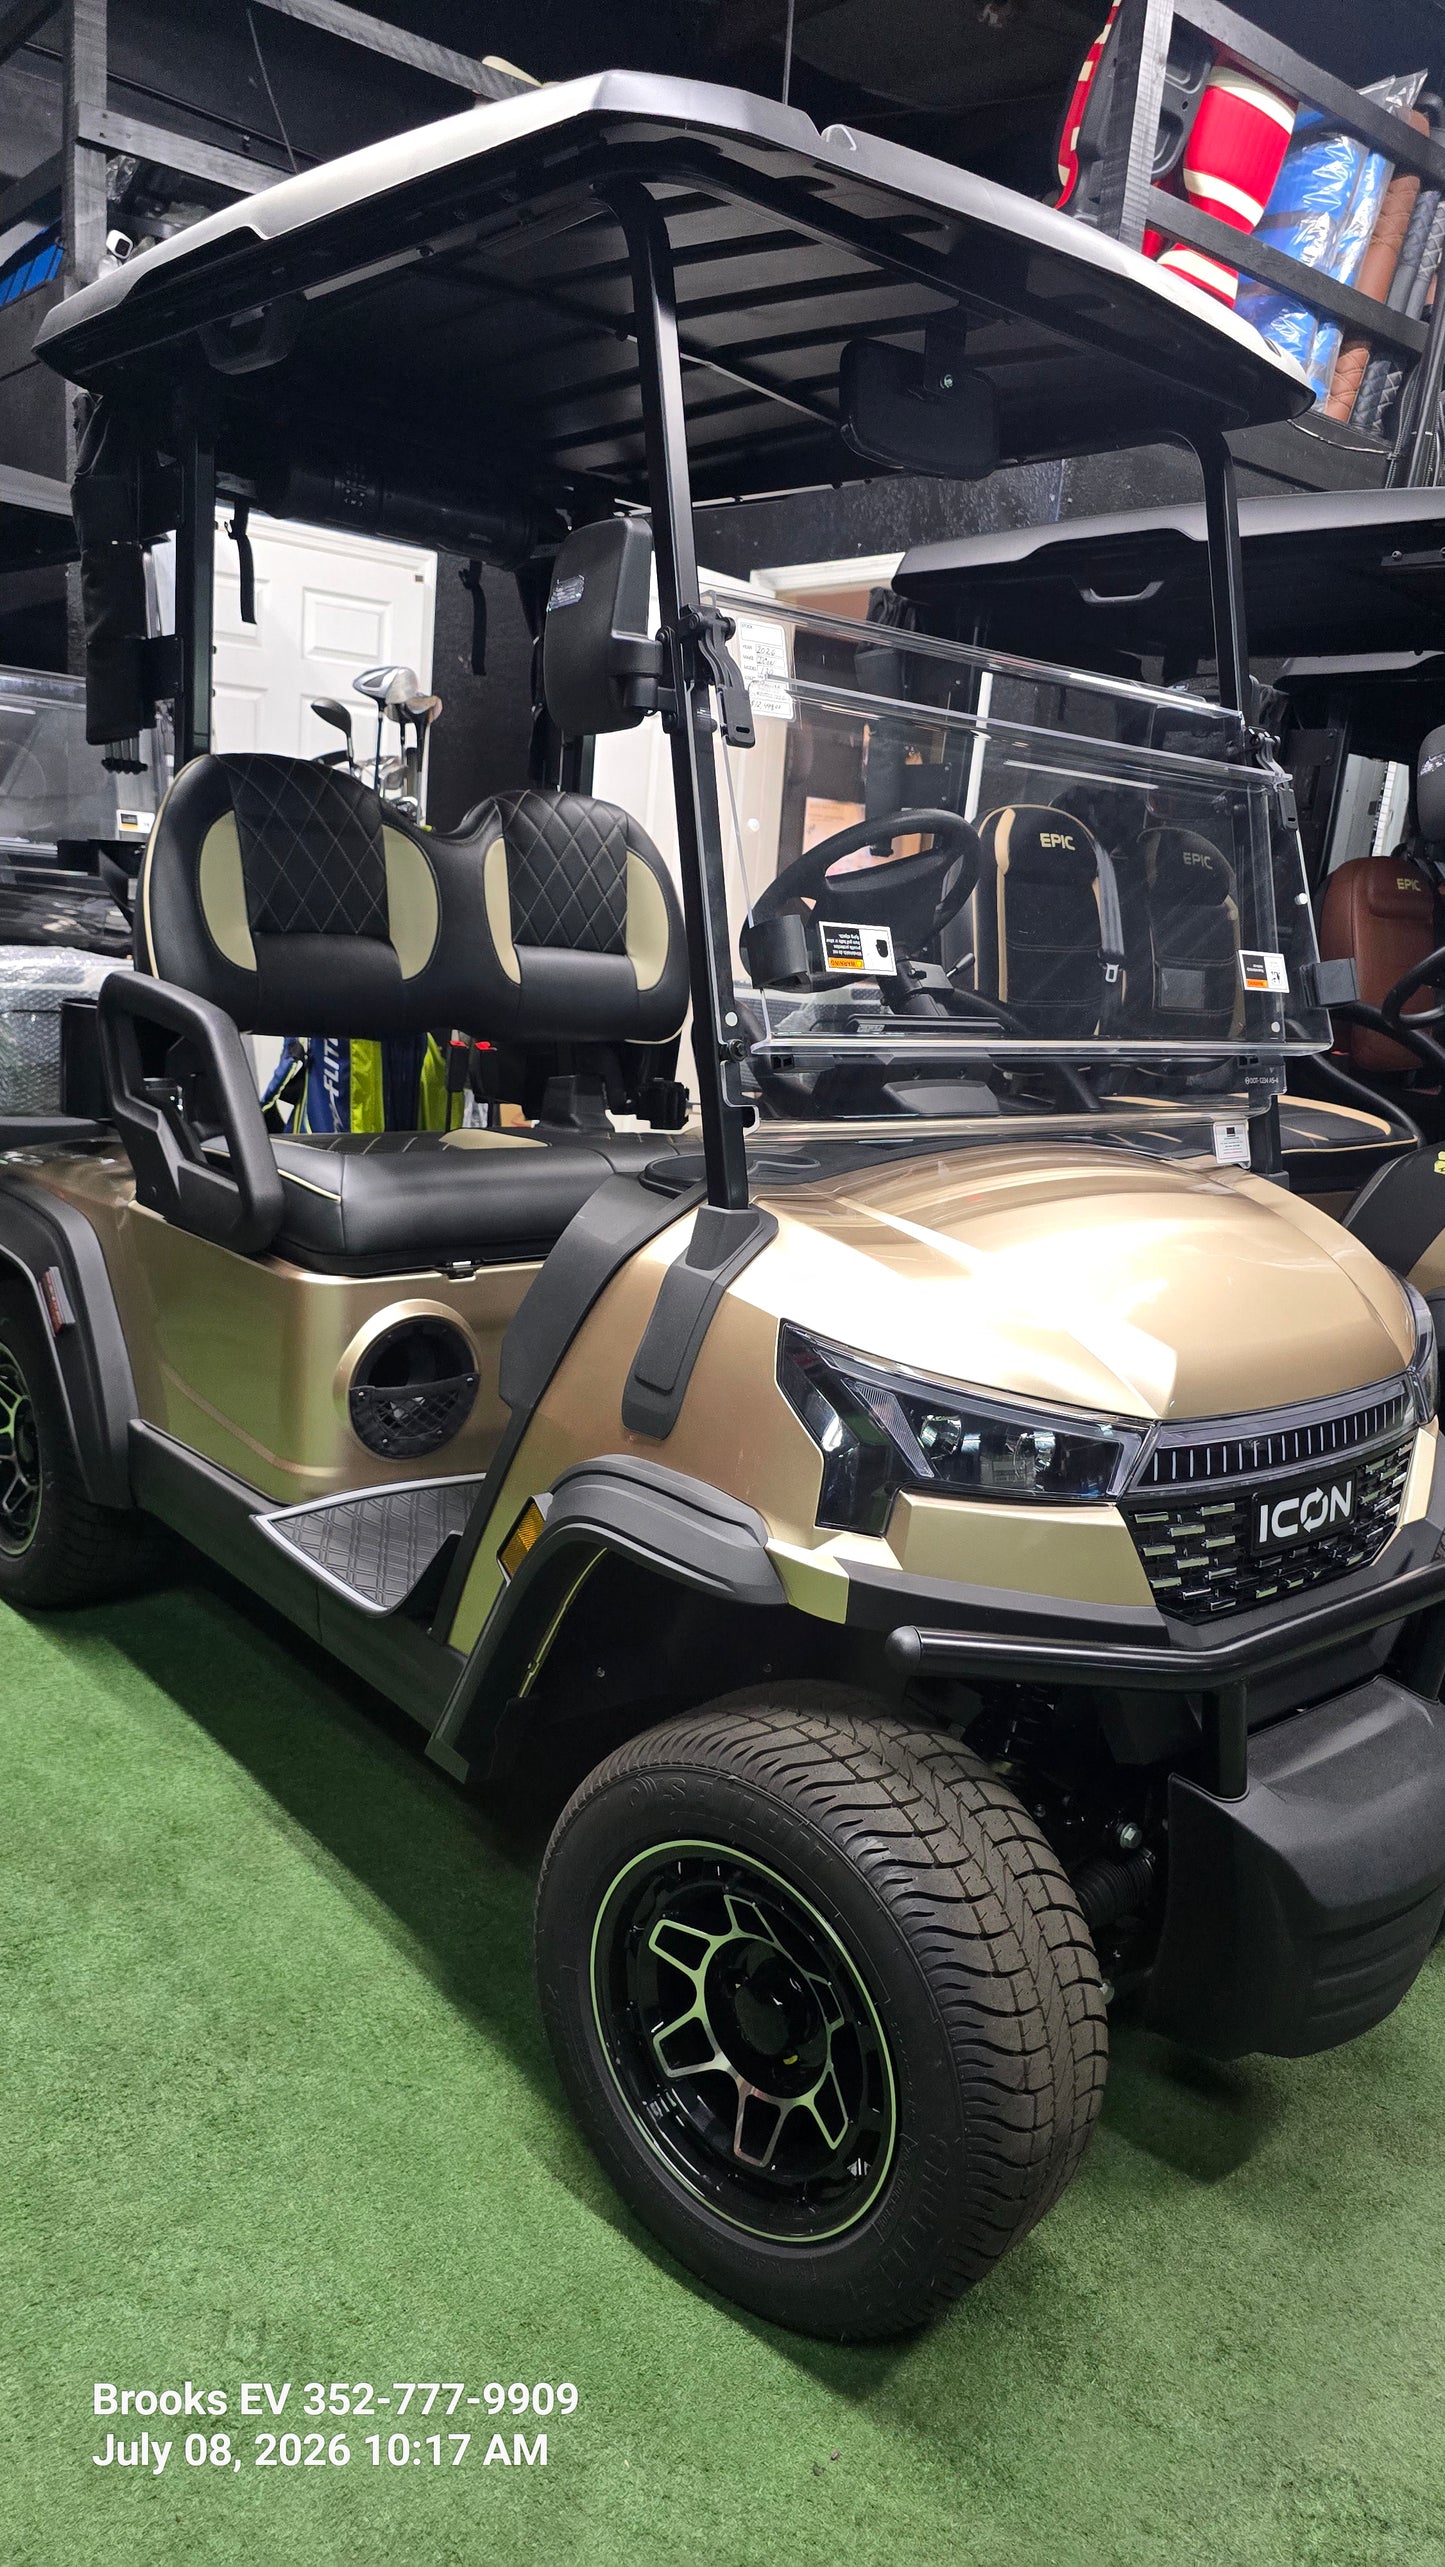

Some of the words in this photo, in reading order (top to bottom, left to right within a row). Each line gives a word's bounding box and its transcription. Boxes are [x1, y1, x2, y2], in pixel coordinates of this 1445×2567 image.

[1039, 832, 1076, 851] EPIC
[1182, 852, 1213, 870] EPIC
[1396, 878, 1421, 892] EPIC
[1259, 1480, 1352, 1543] ICON
